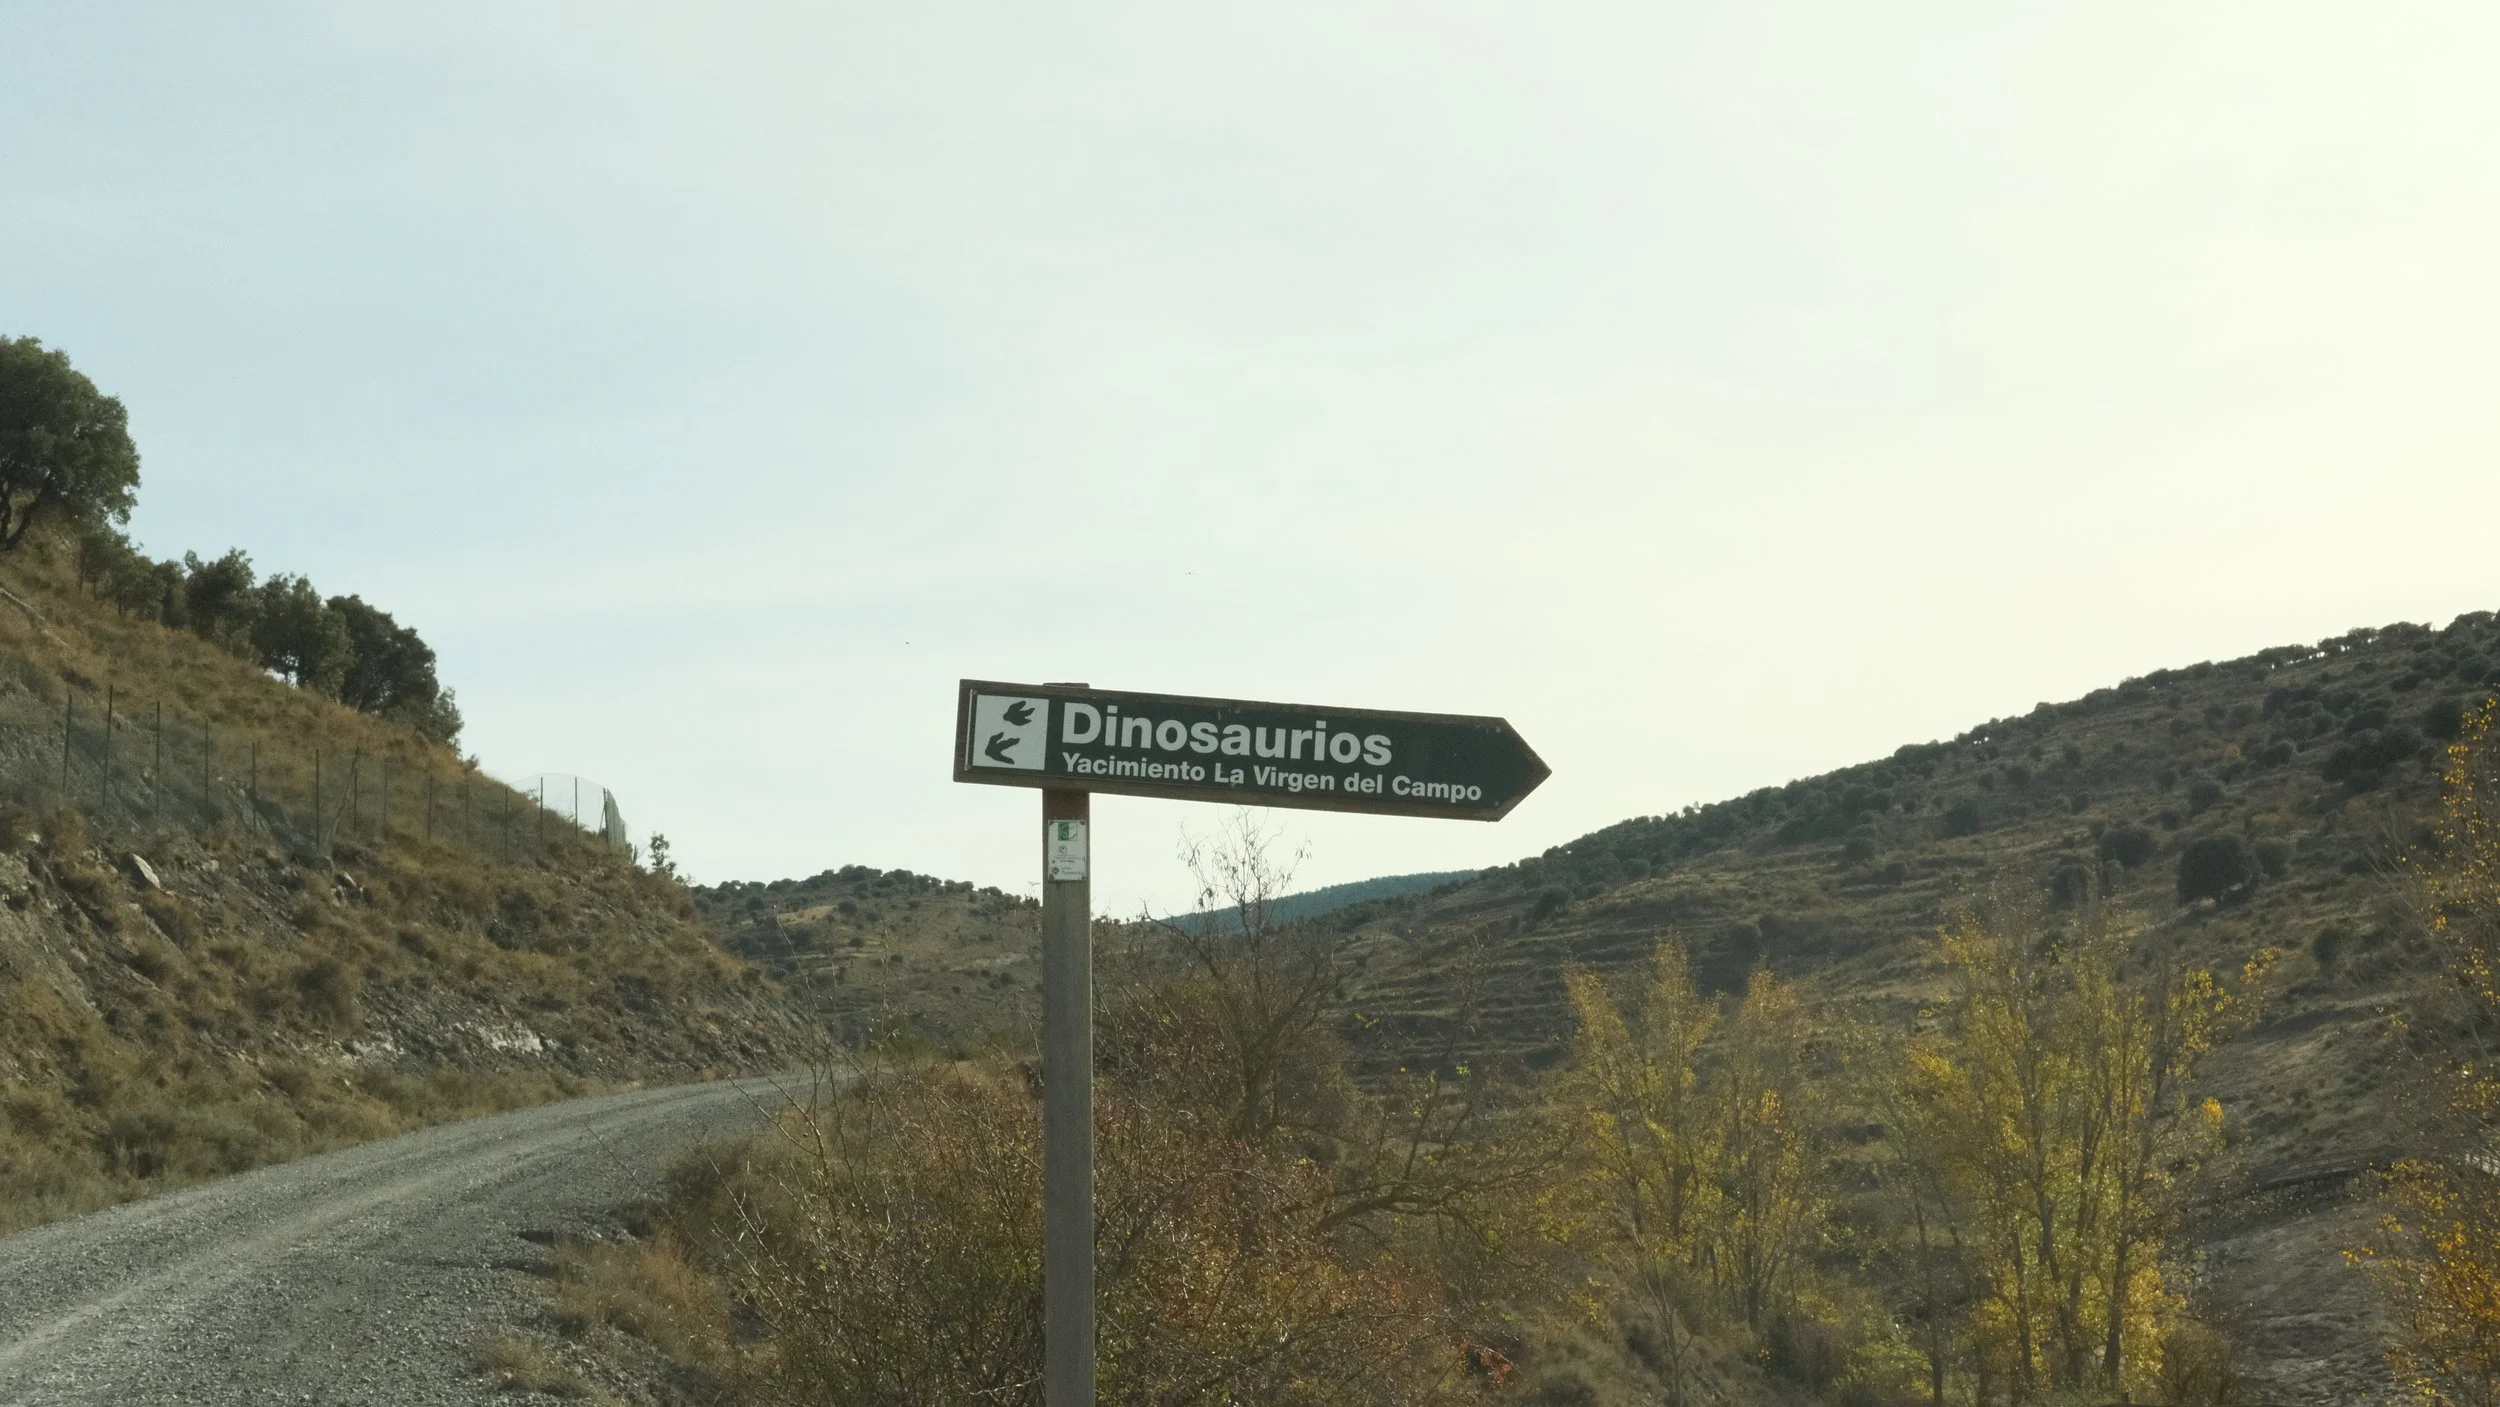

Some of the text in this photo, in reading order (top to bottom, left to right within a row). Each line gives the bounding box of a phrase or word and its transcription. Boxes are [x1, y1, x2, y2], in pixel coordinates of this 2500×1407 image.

[1062, 702, 1392, 766] Dinosaurios
[1062, 751, 1482, 804] Yacimiento La Virgen del Campo
